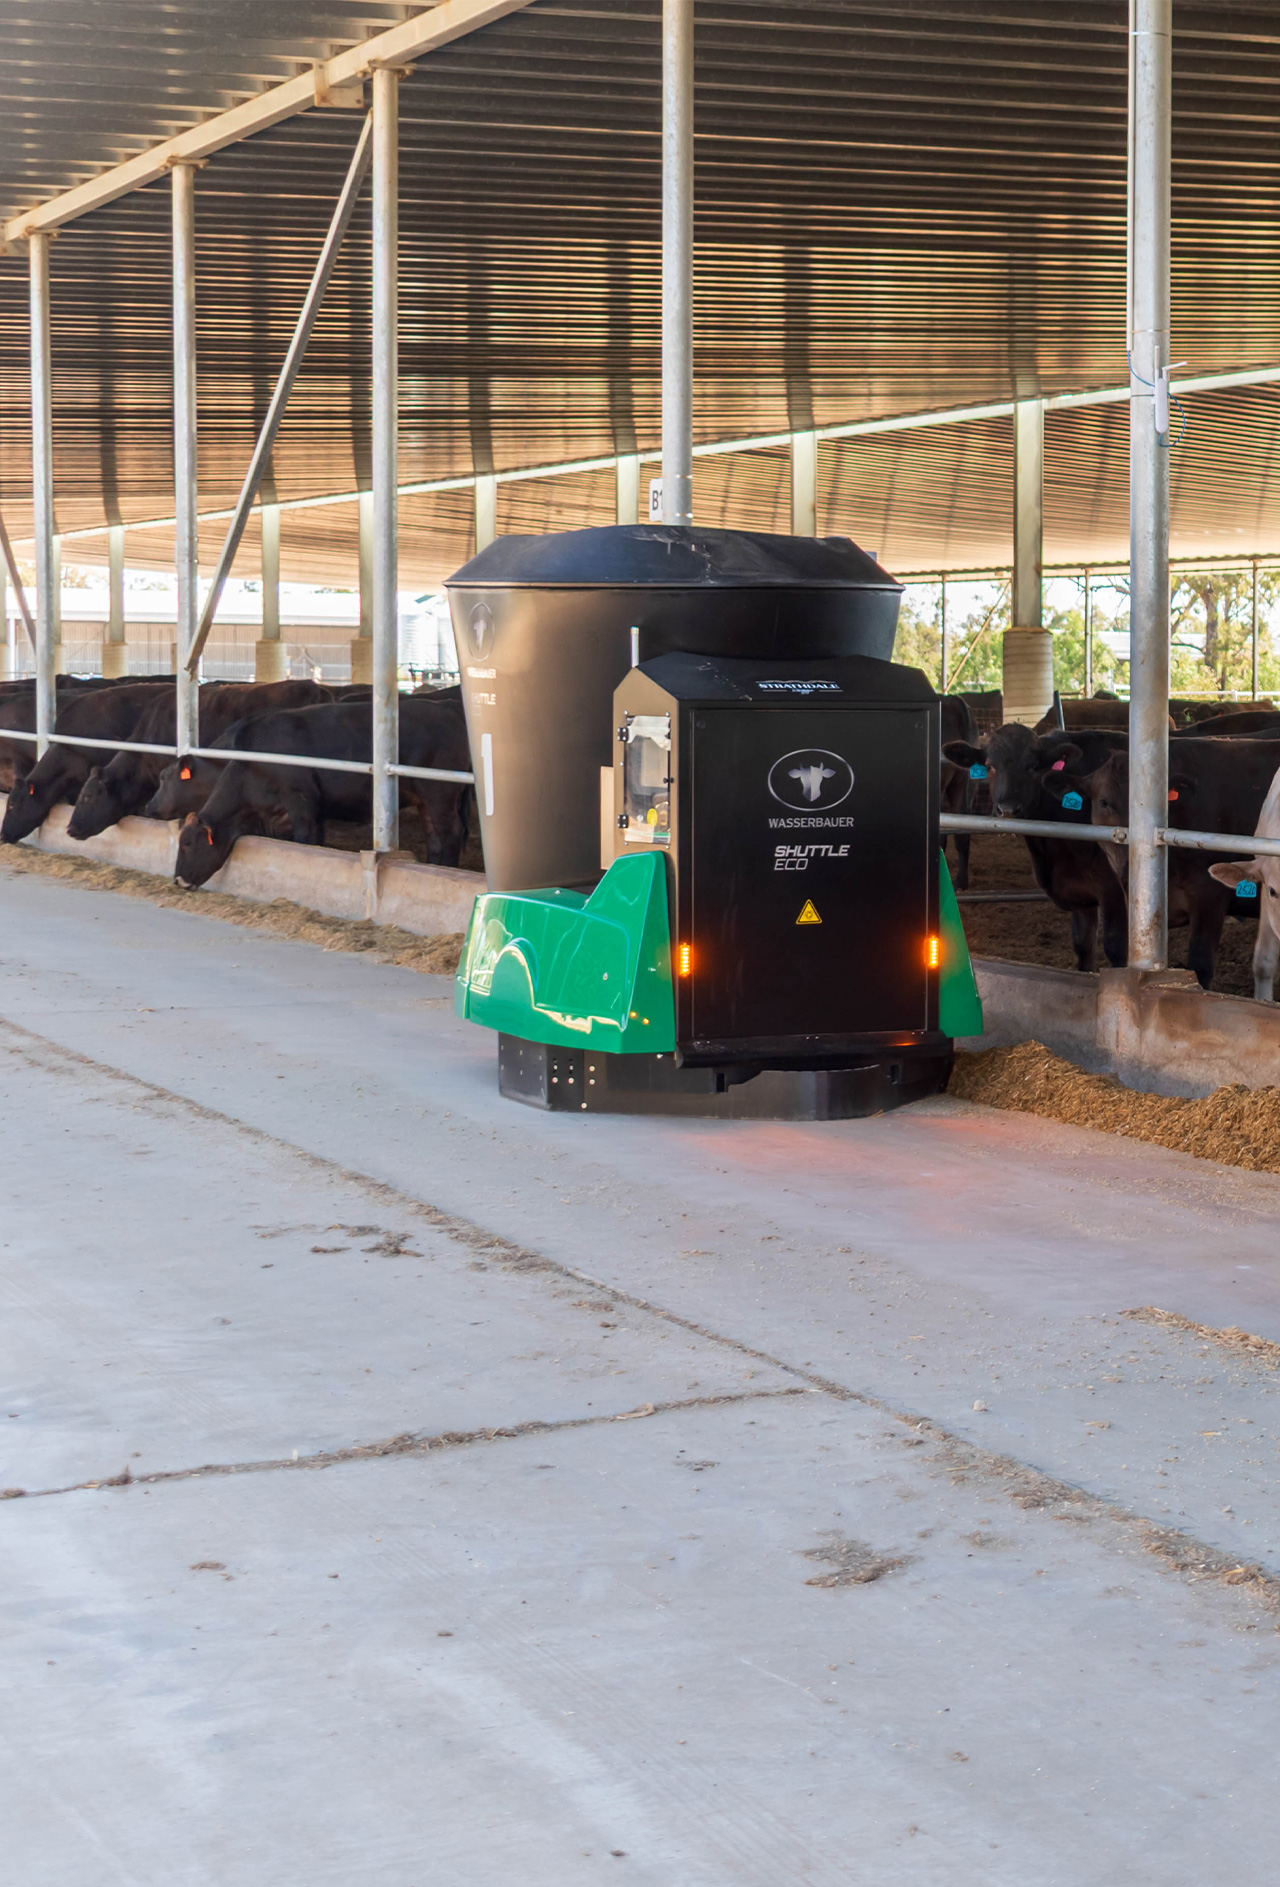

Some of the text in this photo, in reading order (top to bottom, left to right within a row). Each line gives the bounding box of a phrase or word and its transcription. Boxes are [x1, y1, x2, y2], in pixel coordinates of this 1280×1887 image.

[768, 817, 855, 828] WASSERBAUER
[774, 845, 851, 857] SHUTTLE
[774, 858, 809, 870] ECO
